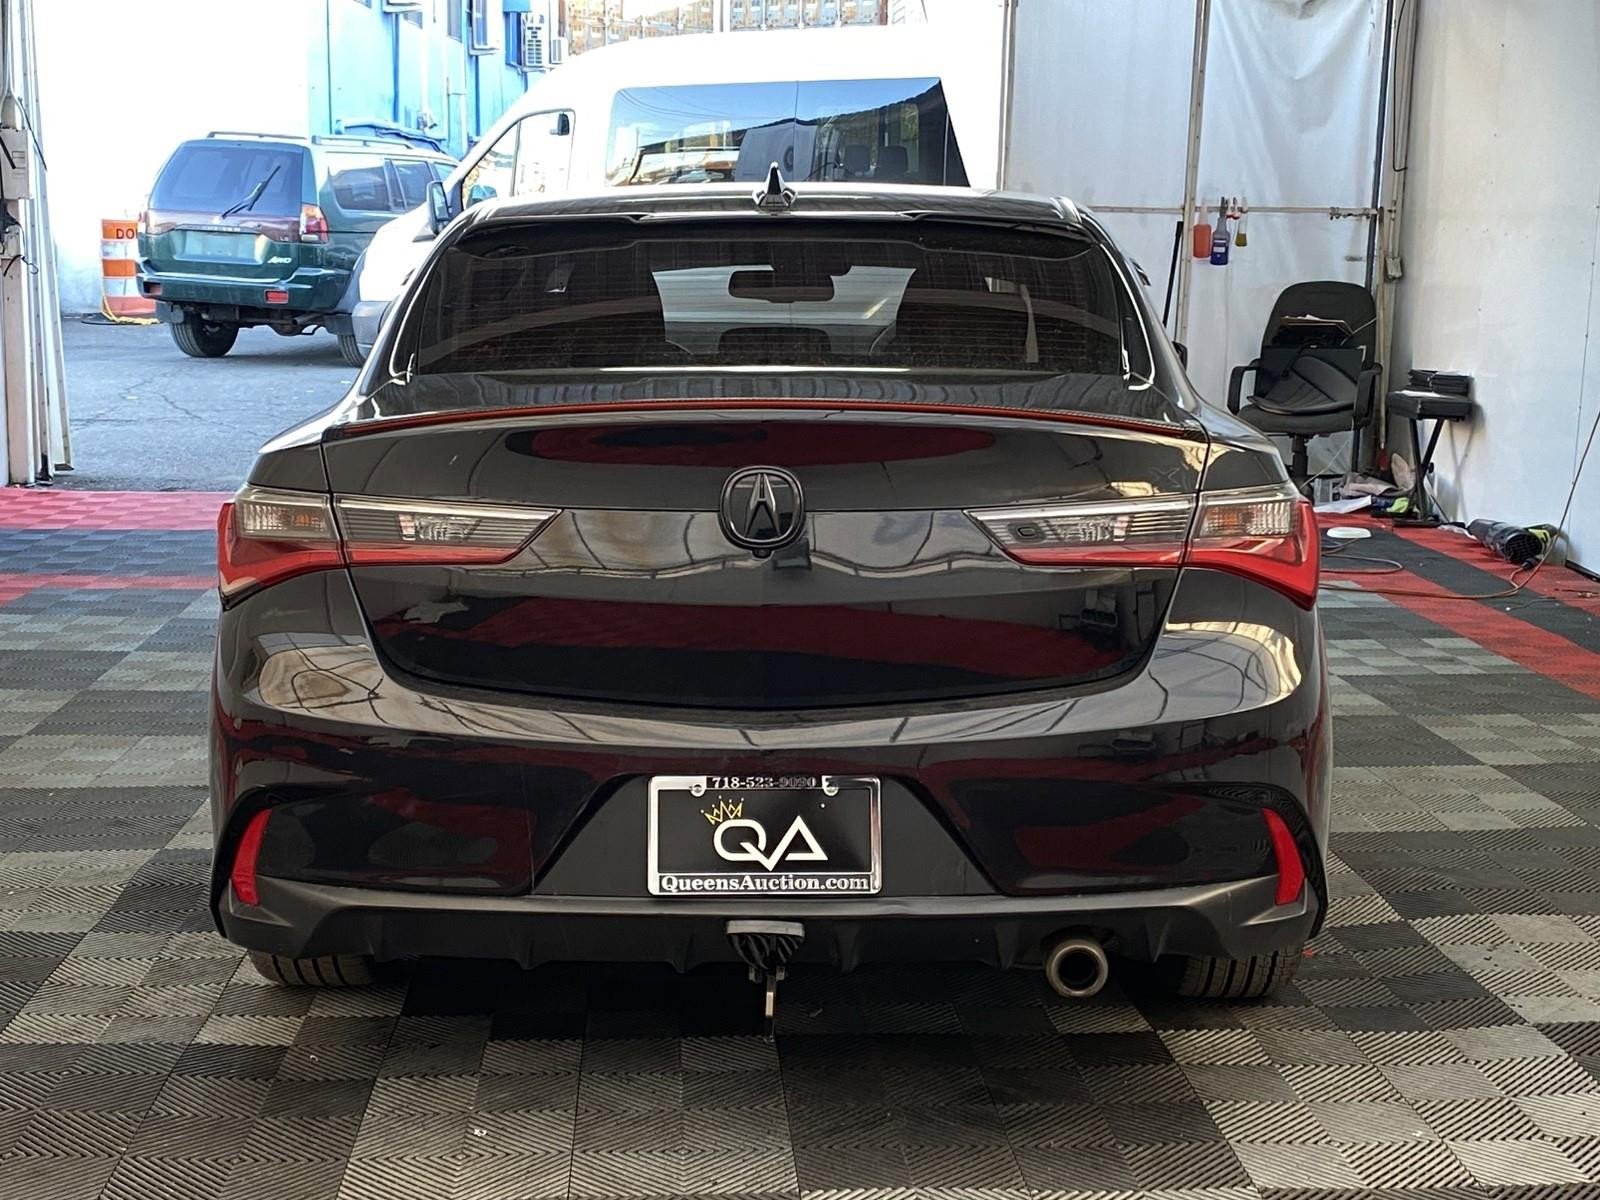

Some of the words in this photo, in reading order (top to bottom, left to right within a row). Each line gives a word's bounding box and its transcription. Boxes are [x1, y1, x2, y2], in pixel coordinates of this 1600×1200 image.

[116, 228, 137, 239] DO
[713, 815, 829, 872] QA
[661, 874, 869, 893] QueensAuction.com
